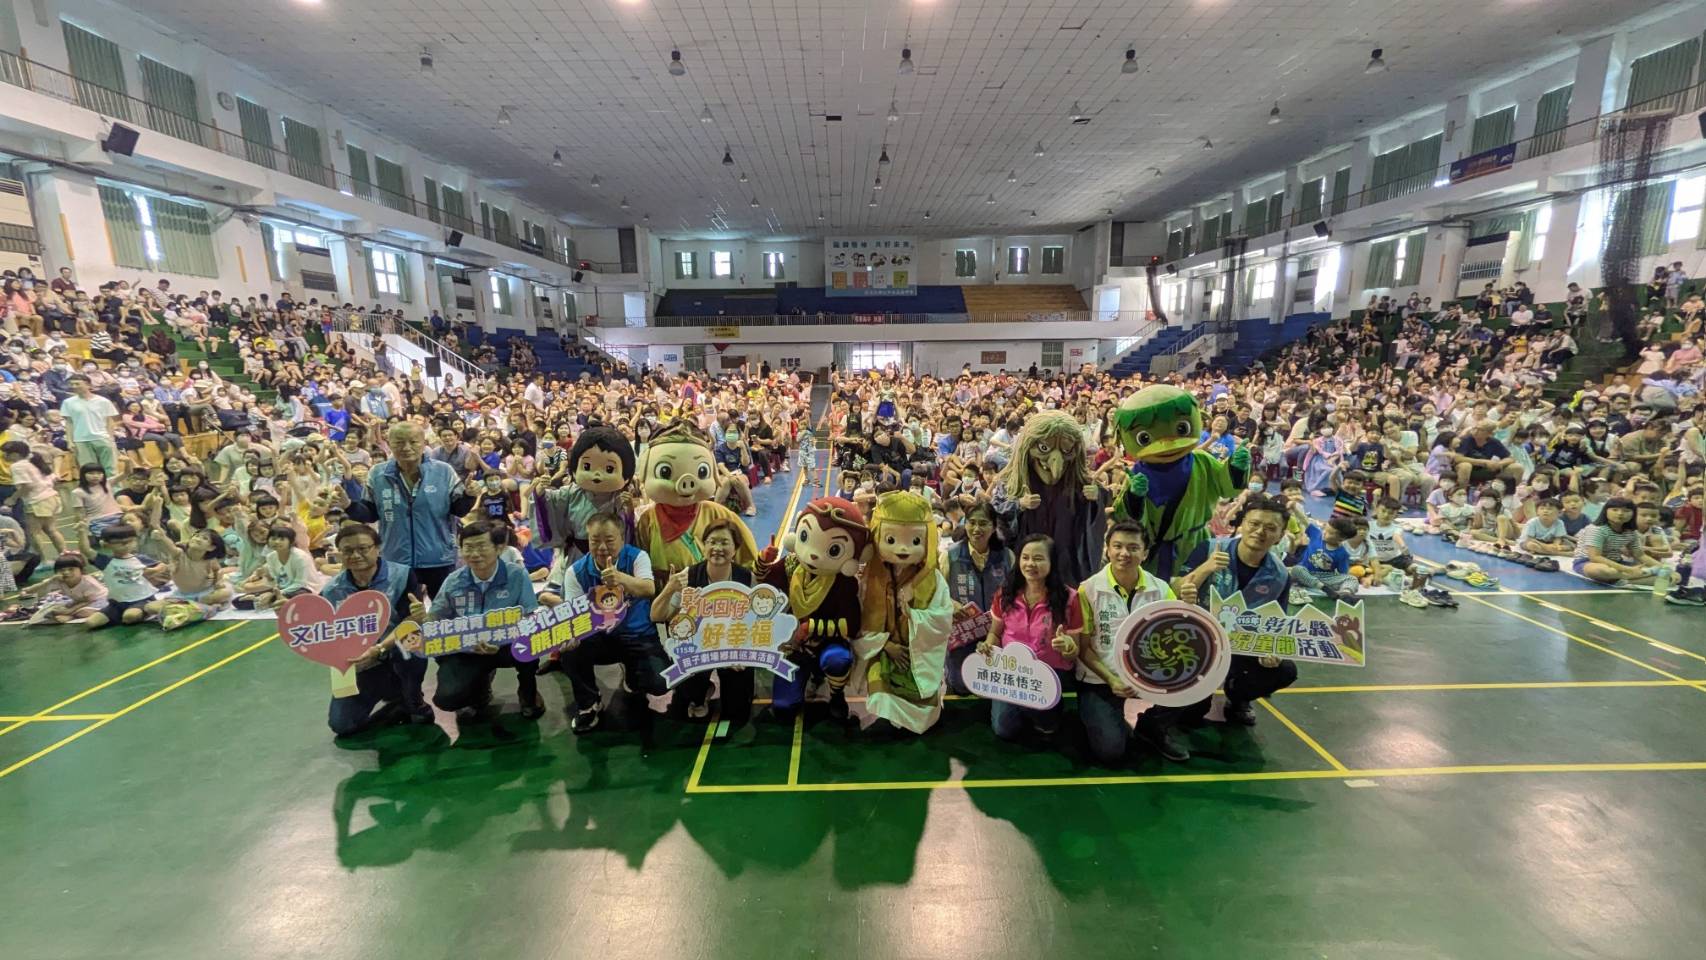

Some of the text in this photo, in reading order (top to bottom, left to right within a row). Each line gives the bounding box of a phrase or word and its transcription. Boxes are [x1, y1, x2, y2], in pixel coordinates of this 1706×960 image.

[517, 594, 590, 637] 彰化囡仔
[681, 587, 751, 620] 彰化囡仔
[288, 613, 379, 647] 文化平權
[703, 620, 774, 649] 好幸福
[1262, 616, 1334, 638] 彰化縣
[1231, 632, 1343, 660] 兒童節活動
[972, 681, 1048, 705] 和美高中活動中心
[976, 667, 1043, 693] 頑皮孫悟空
